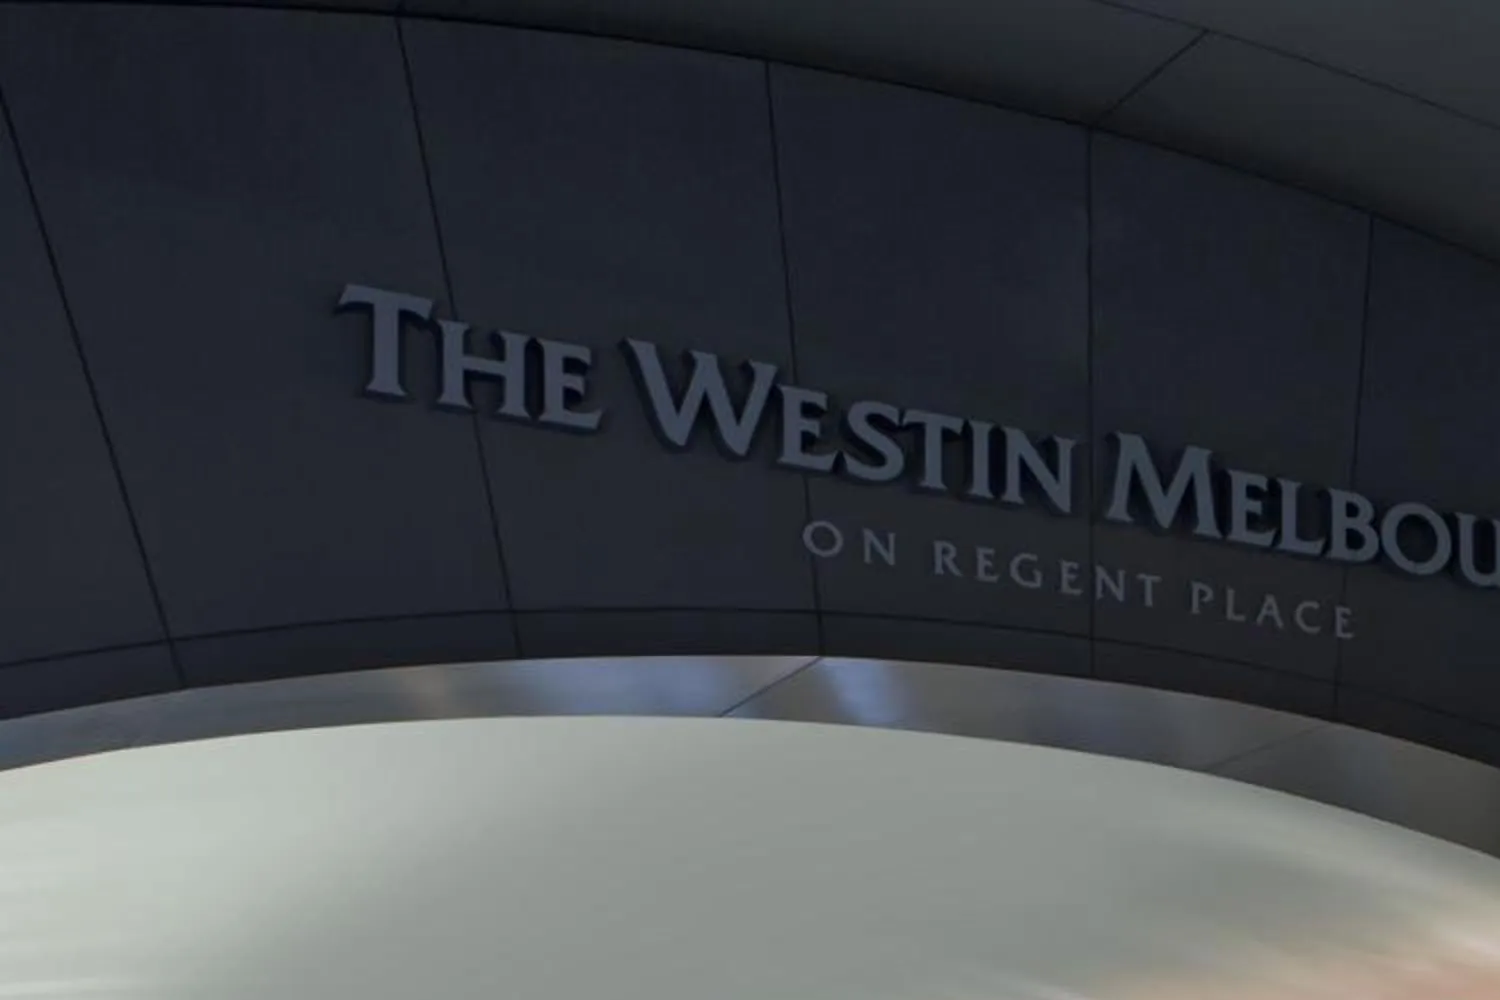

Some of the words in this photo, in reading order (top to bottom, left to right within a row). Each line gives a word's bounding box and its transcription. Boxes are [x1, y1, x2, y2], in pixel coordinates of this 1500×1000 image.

[337, 283, 603, 431] THE
[622, 336, 1077, 515] WESTIN
[802, 520, 896, 567] ON
[933, 540, 1162, 609] REGENT
[1190, 580, 1356, 640] PLACE
